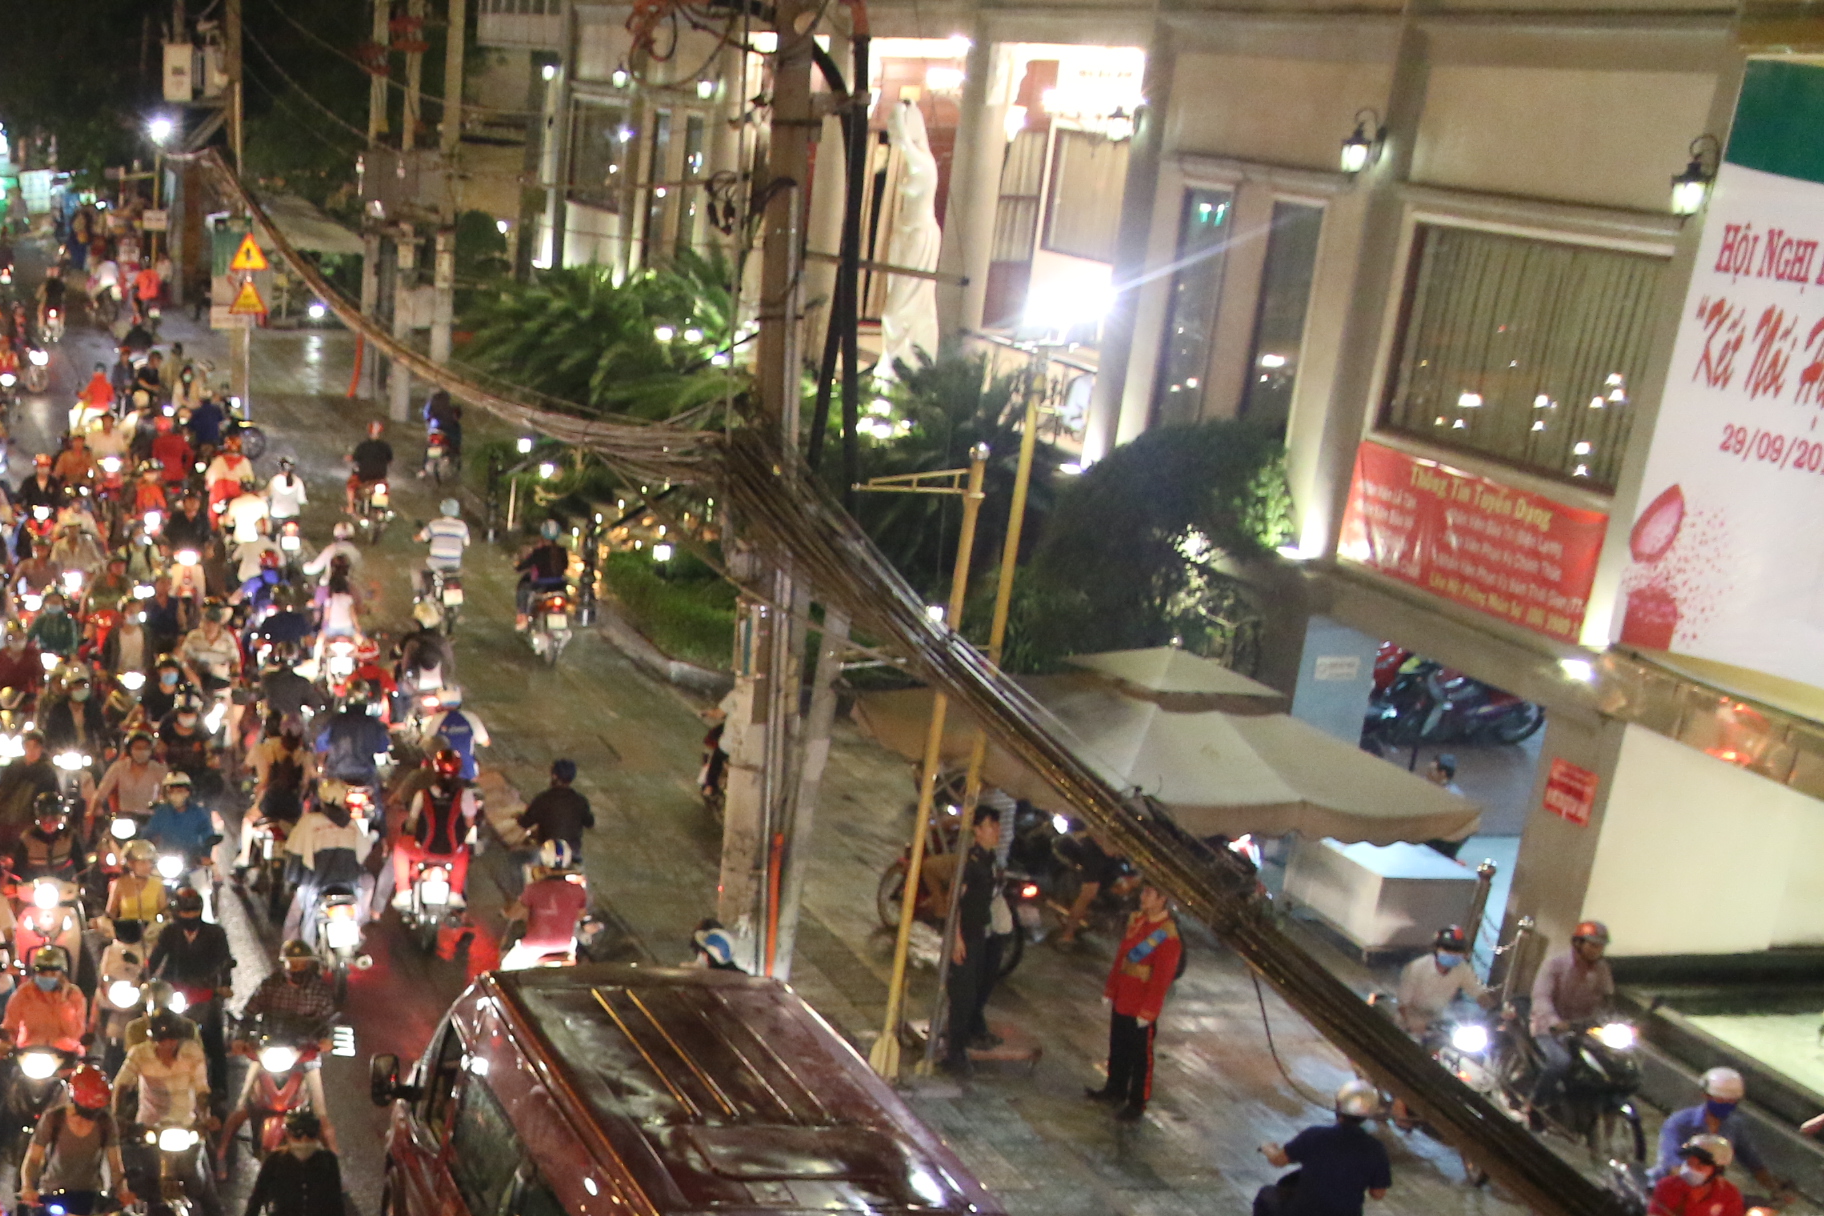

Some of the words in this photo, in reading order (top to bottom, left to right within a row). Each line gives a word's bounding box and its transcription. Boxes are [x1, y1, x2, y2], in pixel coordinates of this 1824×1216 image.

[1714, 222, 1759, 285] HỘI
[1757, 229, 1818, 294] NGHỊ
[1719, 423, 1824, 476] 29/09/20
